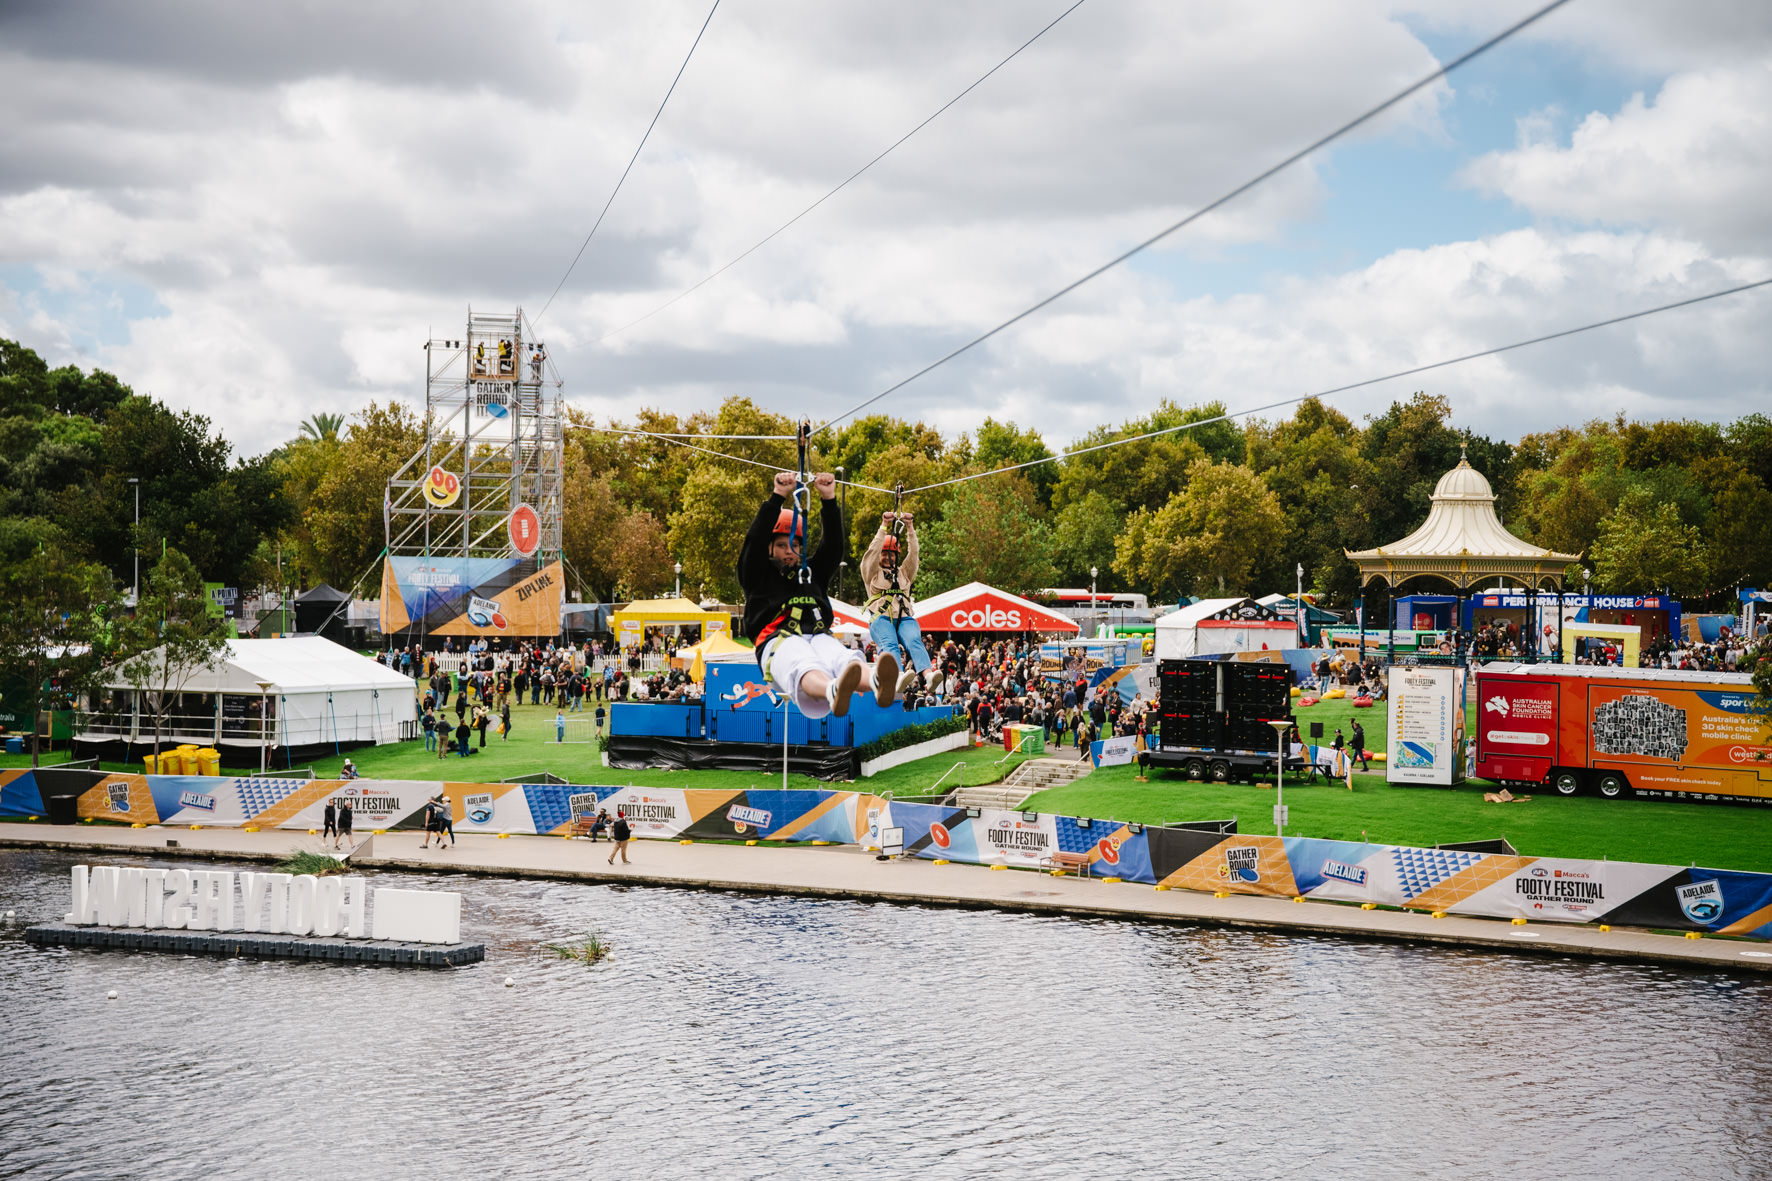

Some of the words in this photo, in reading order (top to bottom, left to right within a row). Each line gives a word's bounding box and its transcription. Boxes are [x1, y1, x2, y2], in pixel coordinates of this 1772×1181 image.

[476, 382, 511, 393] GATHER
[476, 394, 508, 405] ROUND
[515, 572, 554, 602] ZIPLINE
[1593, 597, 1635, 609] HOUSE
[951, 604, 1022, 628] coles
[1702, 715, 1746, 725] Australia's
[1734, 725, 1760, 733] check
[1730, 733, 1752, 741] clinic
[108, 784, 128, 793] GATHER
[110, 792, 128, 802] ROUND
[181, 792, 212, 809] ADELAIDE
[467, 796, 489, 804] ADELAIDE
[571, 794, 596, 806] GATHER
[362, 797, 401, 810] FESTIVAL
[572, 803, 595, 814] ROUND
[643, 805, 677, 819] FESTIVAL
[729, 806, 767, 824] ADELAIDE
[988, 829, 1014, 844] FOOTY
[1015, 831, 1050, 847] FESTIVAL
[1227, 848, 1257, 861] GATHER
[1229, 859, 1256, 871] ROUND
[1323, 861, 1364, 882] ADELAIDE
[1516, 878, 1551, 895] FOOTY
[1554, 880, 1605, 899] FESTIVAL
[1682, 884, 1716, 899] ADELAIDE
[1563, 896, 1595, 904] ROUND
